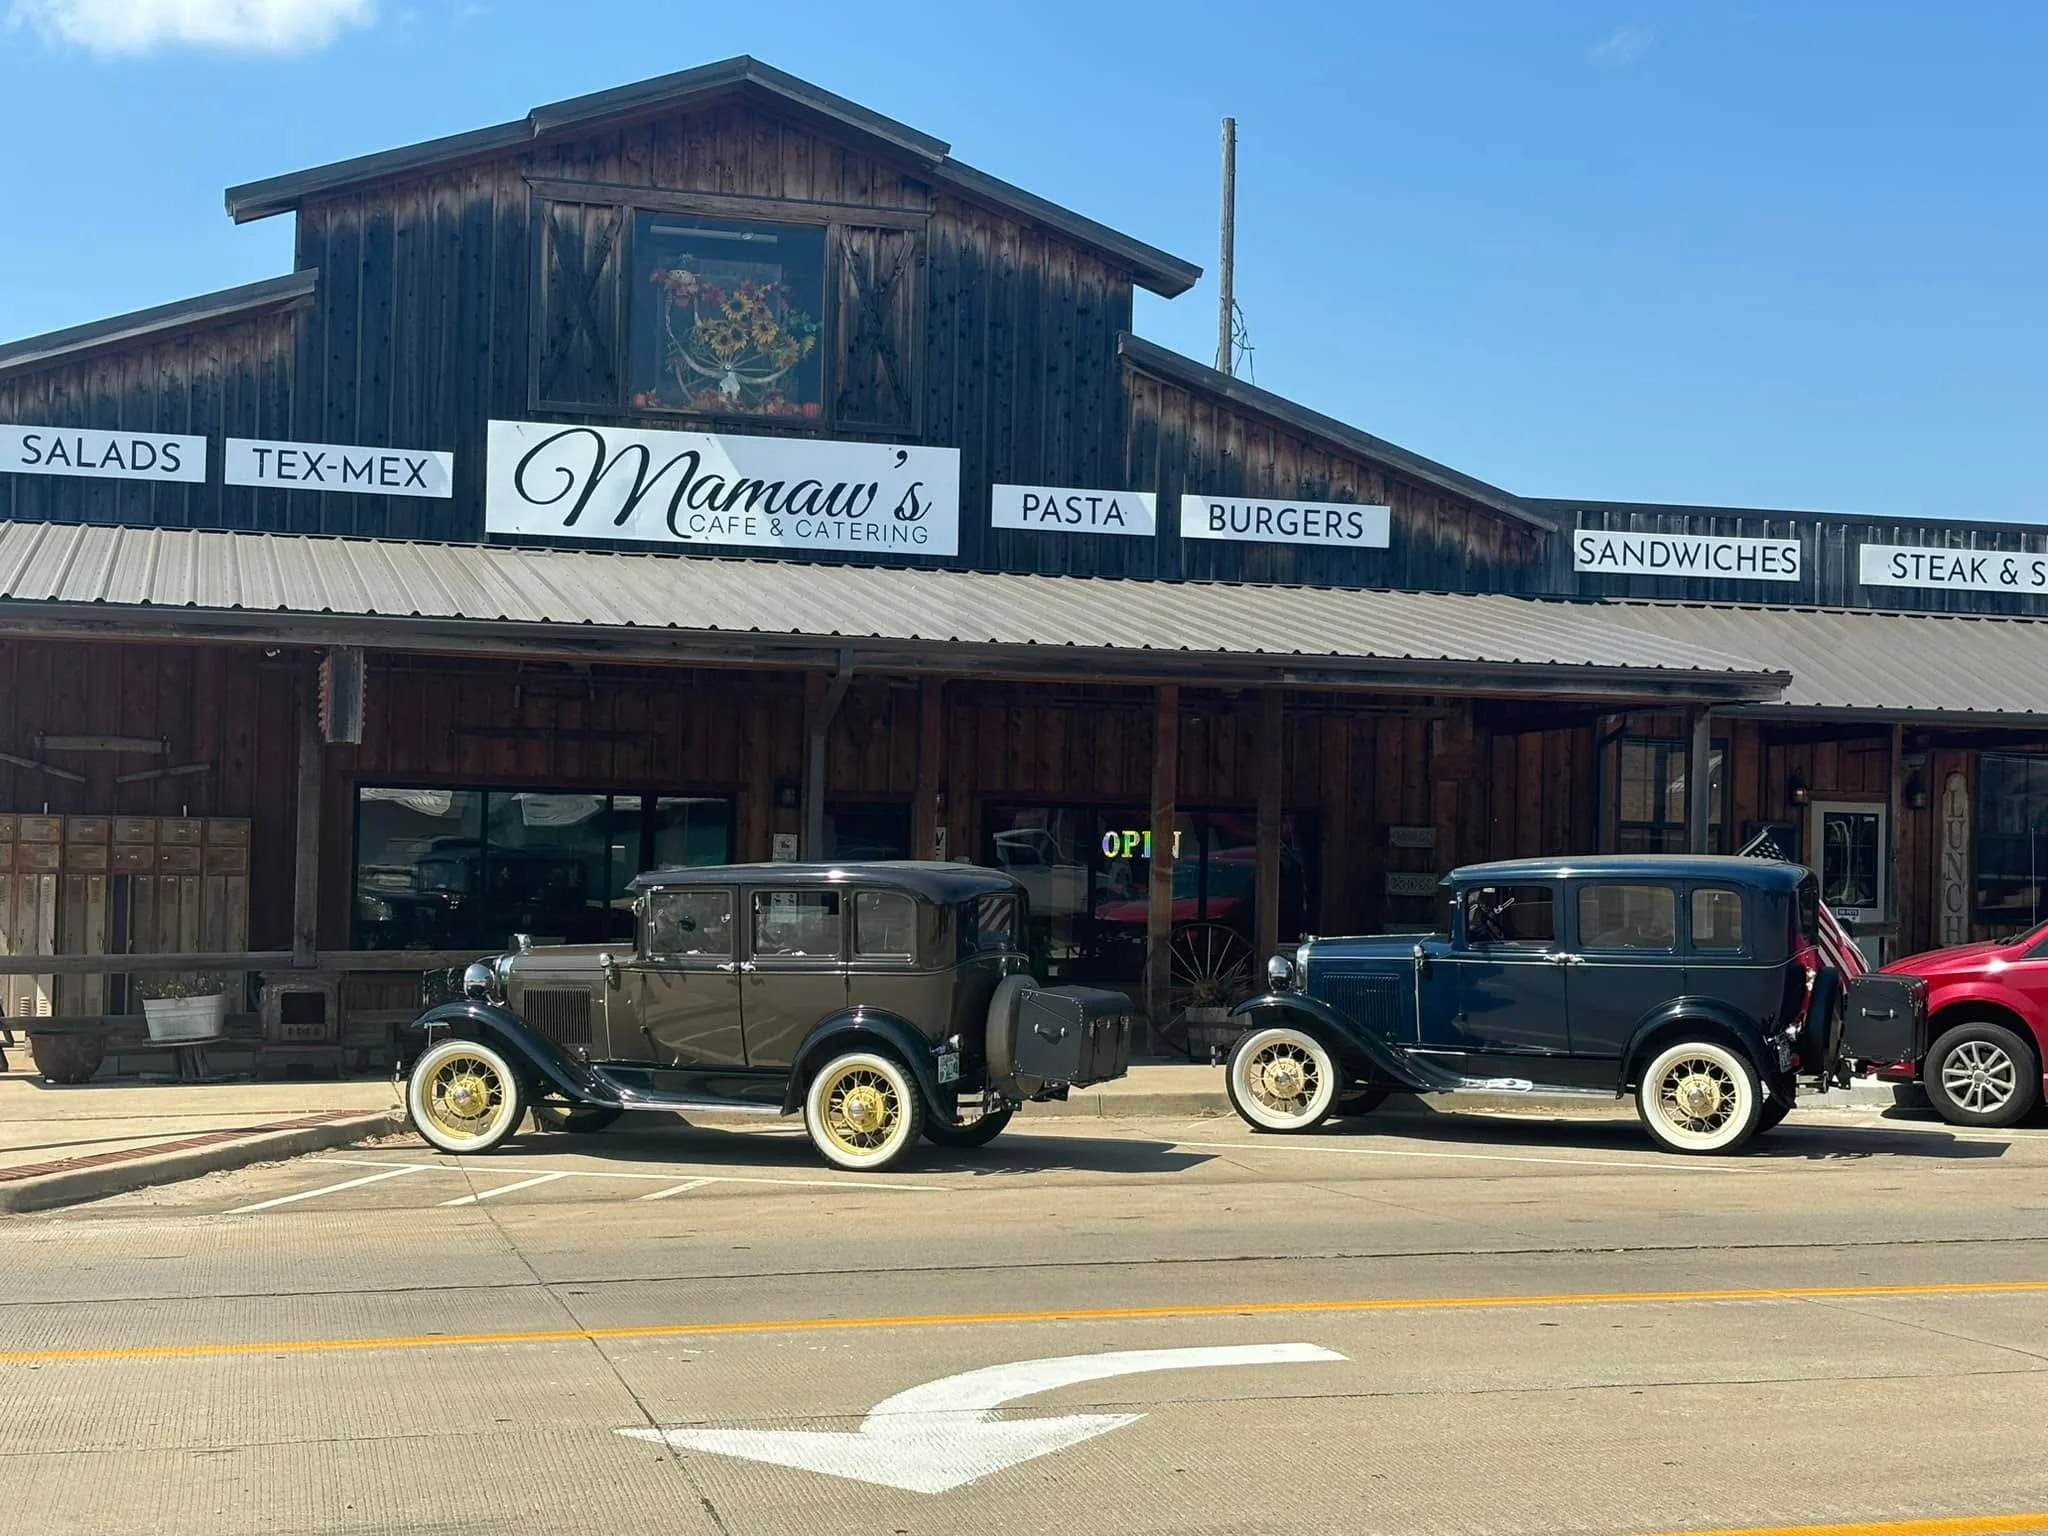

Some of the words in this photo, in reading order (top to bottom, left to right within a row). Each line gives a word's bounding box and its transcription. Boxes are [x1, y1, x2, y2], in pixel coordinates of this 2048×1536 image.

[20, 433, 182, 473] SALADS
[252, 447, 429, 489] TEX-MEX
[514, 427, 933, 540] Mamaw's
[1022, 493, 1126, 527] PASTA
[1208, 503, 1364, 539] BURGERS
[688, 513, 758, 536] CAFE
[769, 518, 786, 538] &
[795, 519, 929, 545] CATERING
[1579, 537, 1798, 574] SANDWICHES
[1891, 552, 1988, 584] STEAK
[1999, 557, 2019, 586] &
[1944, 789, 1965, 945] LUNCH
